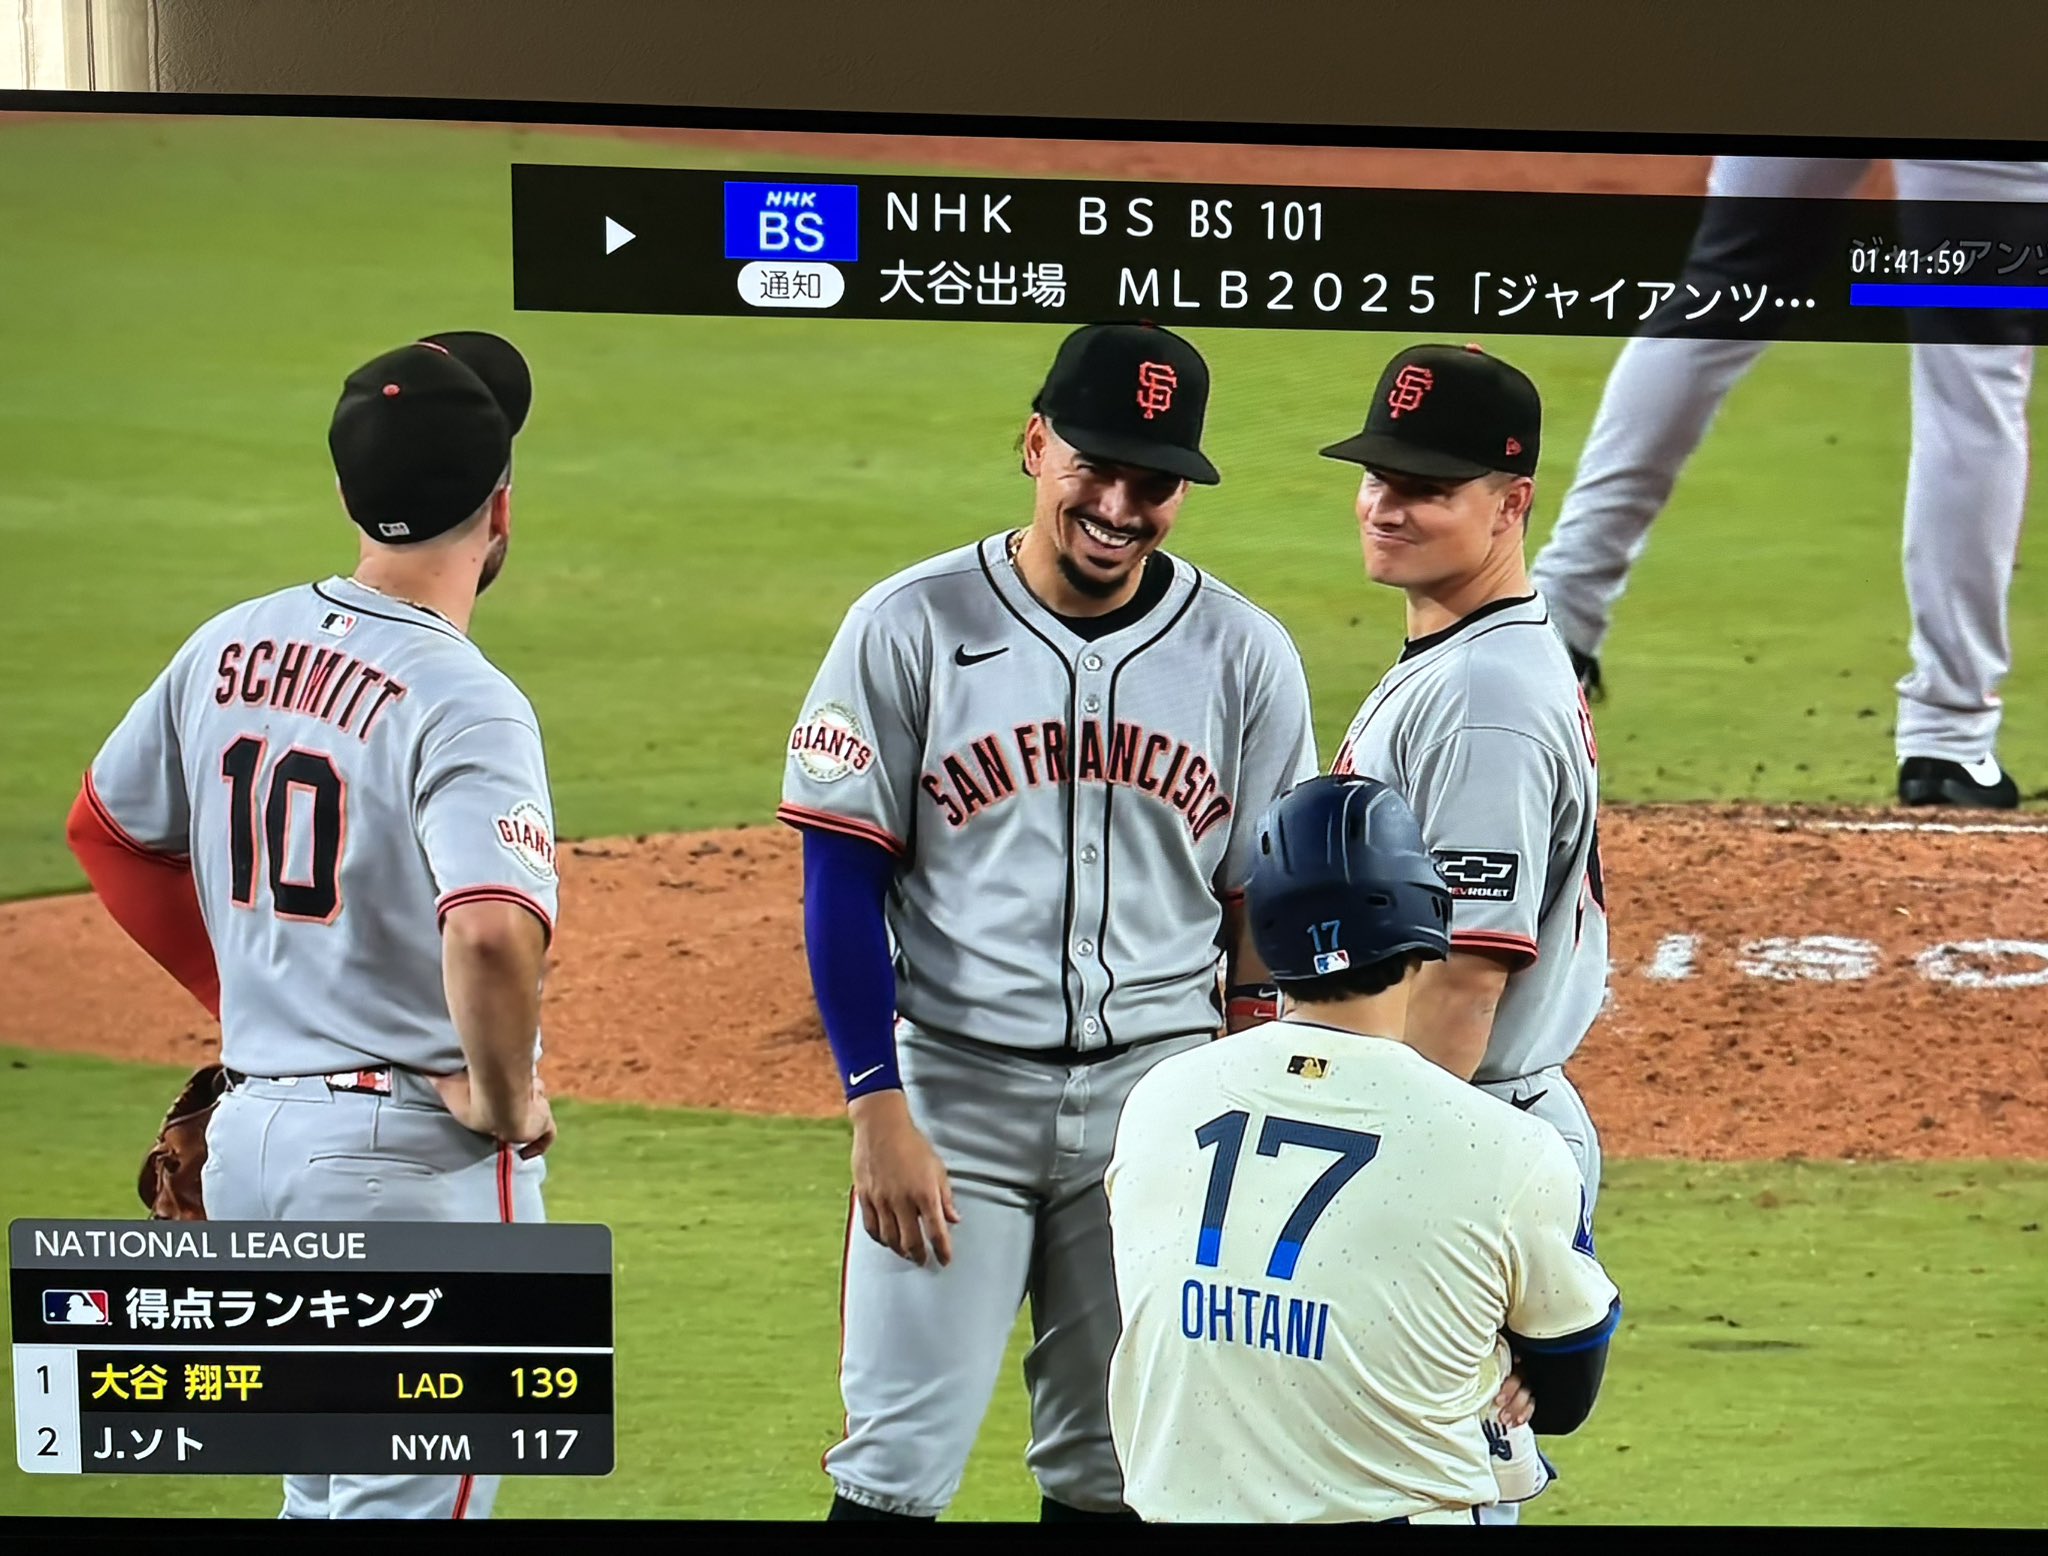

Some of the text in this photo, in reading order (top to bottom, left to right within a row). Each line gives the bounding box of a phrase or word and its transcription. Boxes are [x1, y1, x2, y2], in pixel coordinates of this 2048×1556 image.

[765, 191, 817, 208] NHK
[886, 192, 1323, 243] NHK BS BS 101
[759, 213, 825, 253] BS
[1852, 248, 1966, 275] 01:41:59
[759, 270, 821, 300] 通知
[879, 260, 1067, 309] 大谷出場
[214, 640, 408, 743] SCHMITT
[790, 724, 872, 771] GIANTS
[921, 718, 1232, 843] SAN FRANCISCO
[221, 733, 347, 926] 10
[497, 818, 553, 864] GIANT
[1448, 886, 1510, 897] EVROLET
[1306, 920, 1342, 952] 17
[1194, 1109, 1382, 1281] 17
[34, 1230, 366, 1260] NATIONAL LEAGUE
[126, 1287, 443, 1330] 得点ランキング
[1182, 1279, 1329, 1361] OHTANI
[37, 1364, 578, 1402] 1 大谷 翔平 LAD 139
[38, 1428, 579, 1461] 2 J.ソト NYM 117
